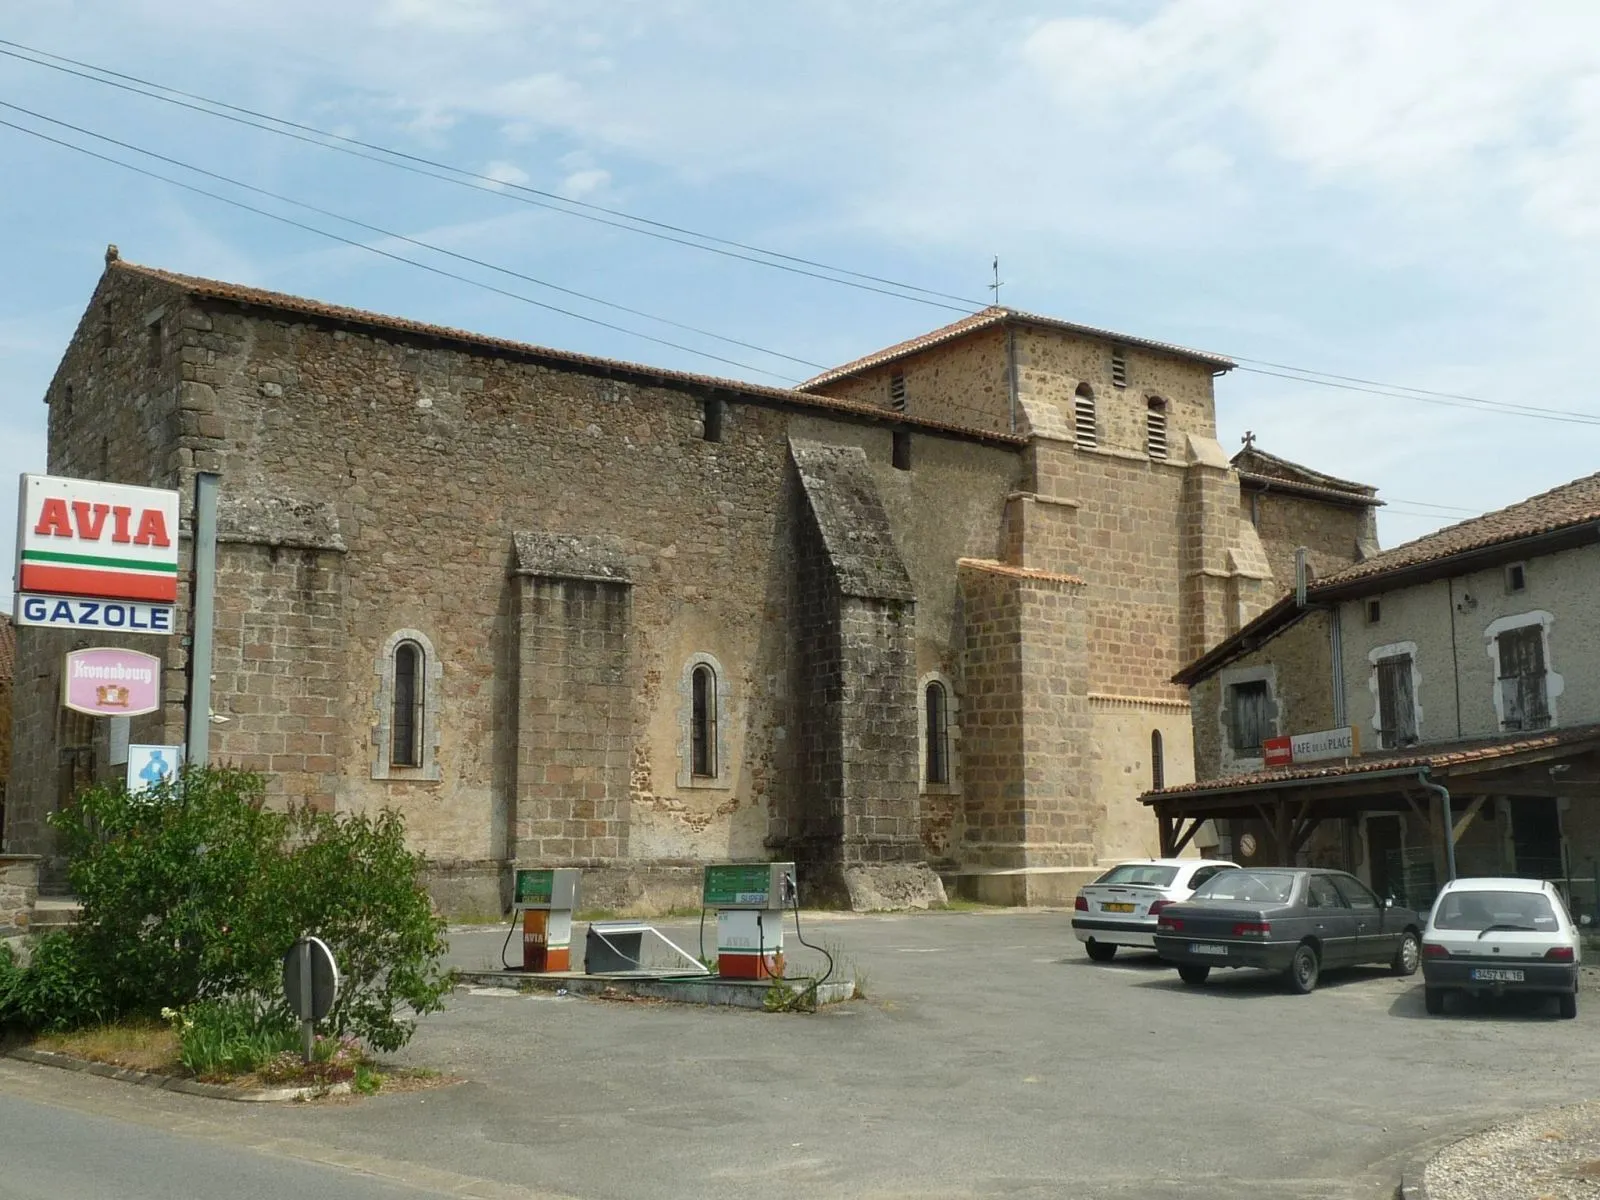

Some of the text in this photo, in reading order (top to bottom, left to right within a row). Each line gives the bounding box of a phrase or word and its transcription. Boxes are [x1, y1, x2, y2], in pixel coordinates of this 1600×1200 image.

[34, 498, 171, 547] AVIA
[24, 598, 170, 630] GAZOLE
[72, 660, 152, 684] Kronenbourg
[1328, 736, 1352, 750] PLACE
[741, 894, 765, 903] SUPER
[524, 932, 544, 943] AVIA
[726, 937, 751, 947] AVIA
